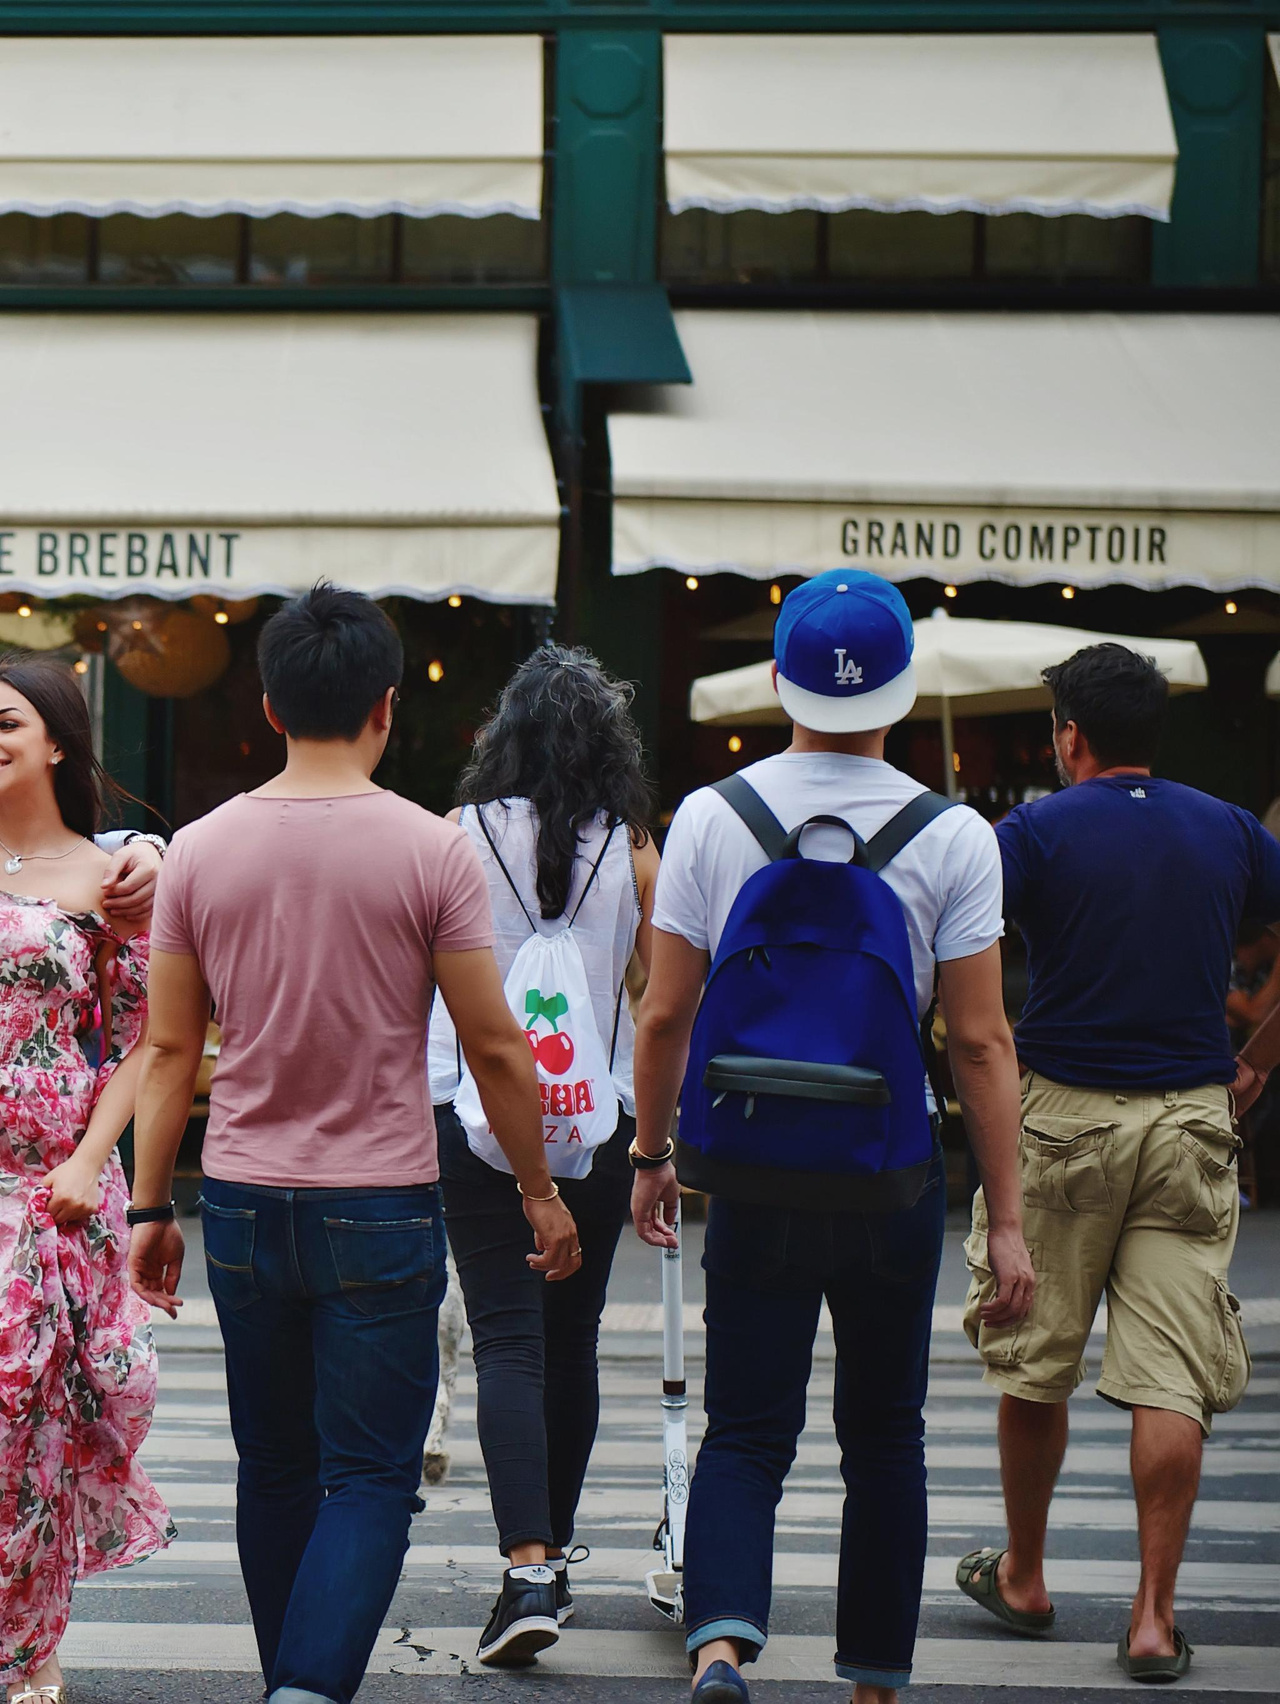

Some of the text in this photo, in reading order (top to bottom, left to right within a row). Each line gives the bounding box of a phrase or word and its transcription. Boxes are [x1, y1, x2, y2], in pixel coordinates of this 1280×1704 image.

[37, 532, 240, 578] BREBANT
[841, 519, 1167, 563] GRAND COMPTOIR
[834, 648, 863, 685] LA
